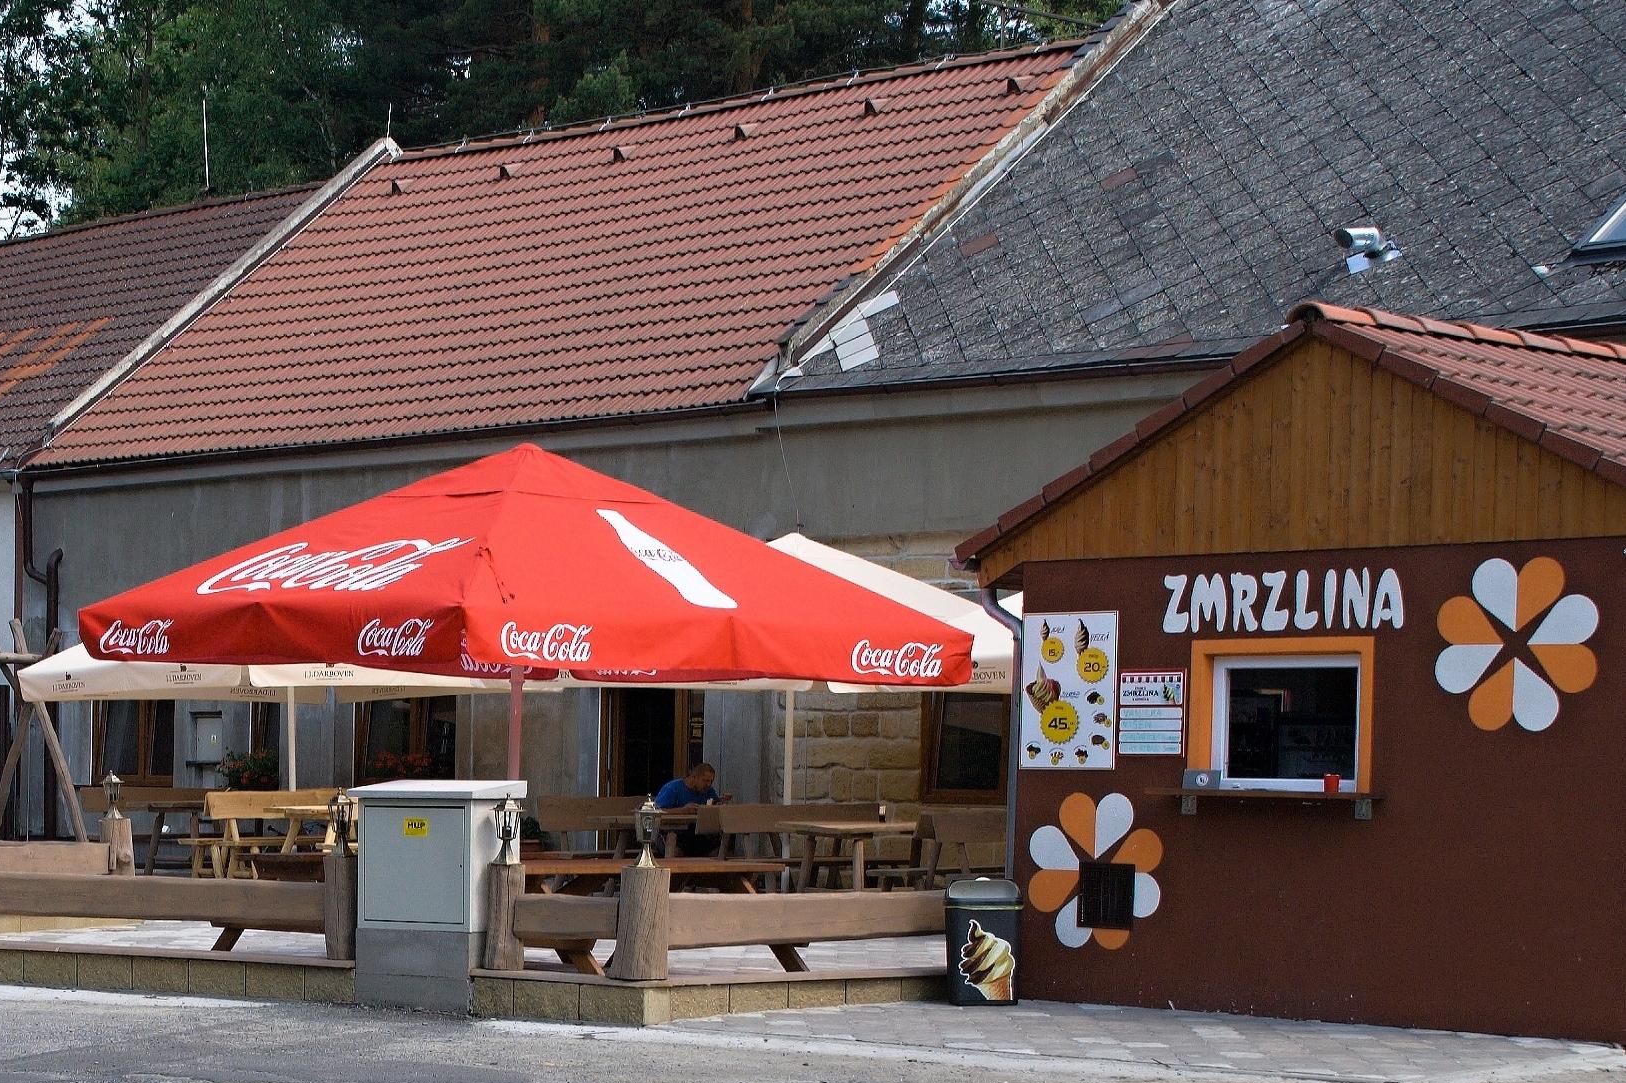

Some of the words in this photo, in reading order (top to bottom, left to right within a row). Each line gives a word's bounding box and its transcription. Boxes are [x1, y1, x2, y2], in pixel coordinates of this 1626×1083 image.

[1162, 566, 1404, 634] ZMRZLINA
[500, 620, 593, 662] Coca-Cola
[850, 638, 944, 678] Coca-Cola
[407, 821, 426, 829] HUP
